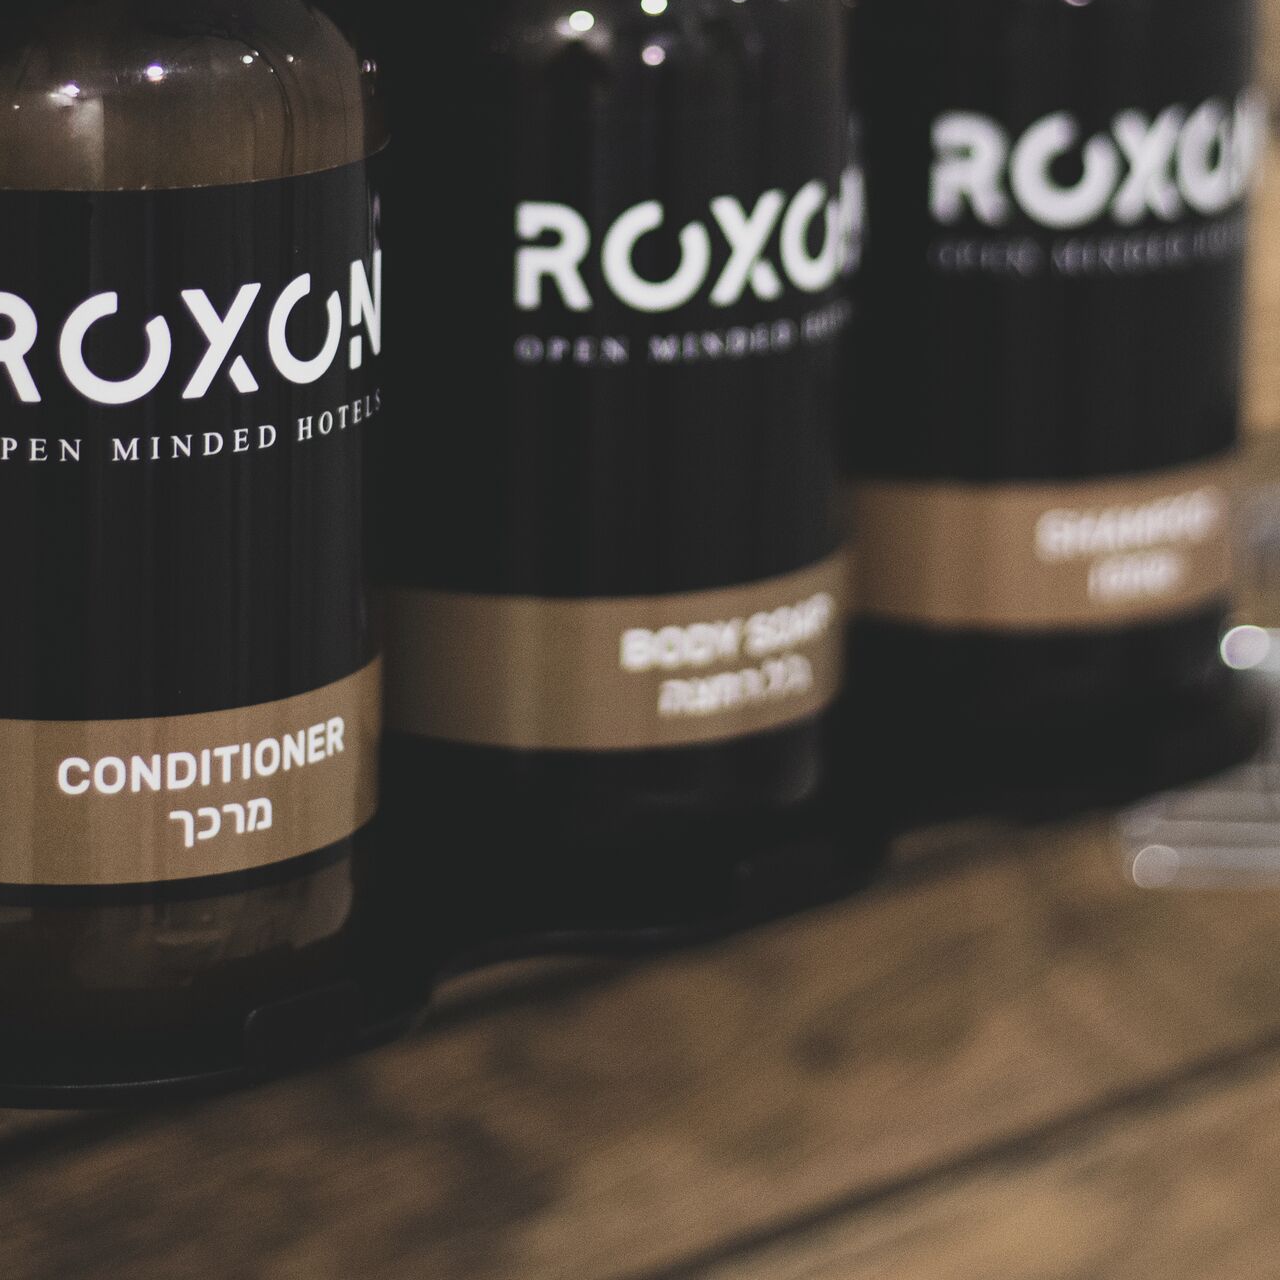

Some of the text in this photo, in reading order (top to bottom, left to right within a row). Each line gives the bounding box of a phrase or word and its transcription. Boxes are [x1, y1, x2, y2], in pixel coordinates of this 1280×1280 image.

[111, 424, 277, 462] MINDED
[297, 389, 382, 442] HOTELS
[622, 618, 742, 671] BODY
[58, 717, 345, 795] CONDITIONER
[170, 797, 273, 848] מרכך
